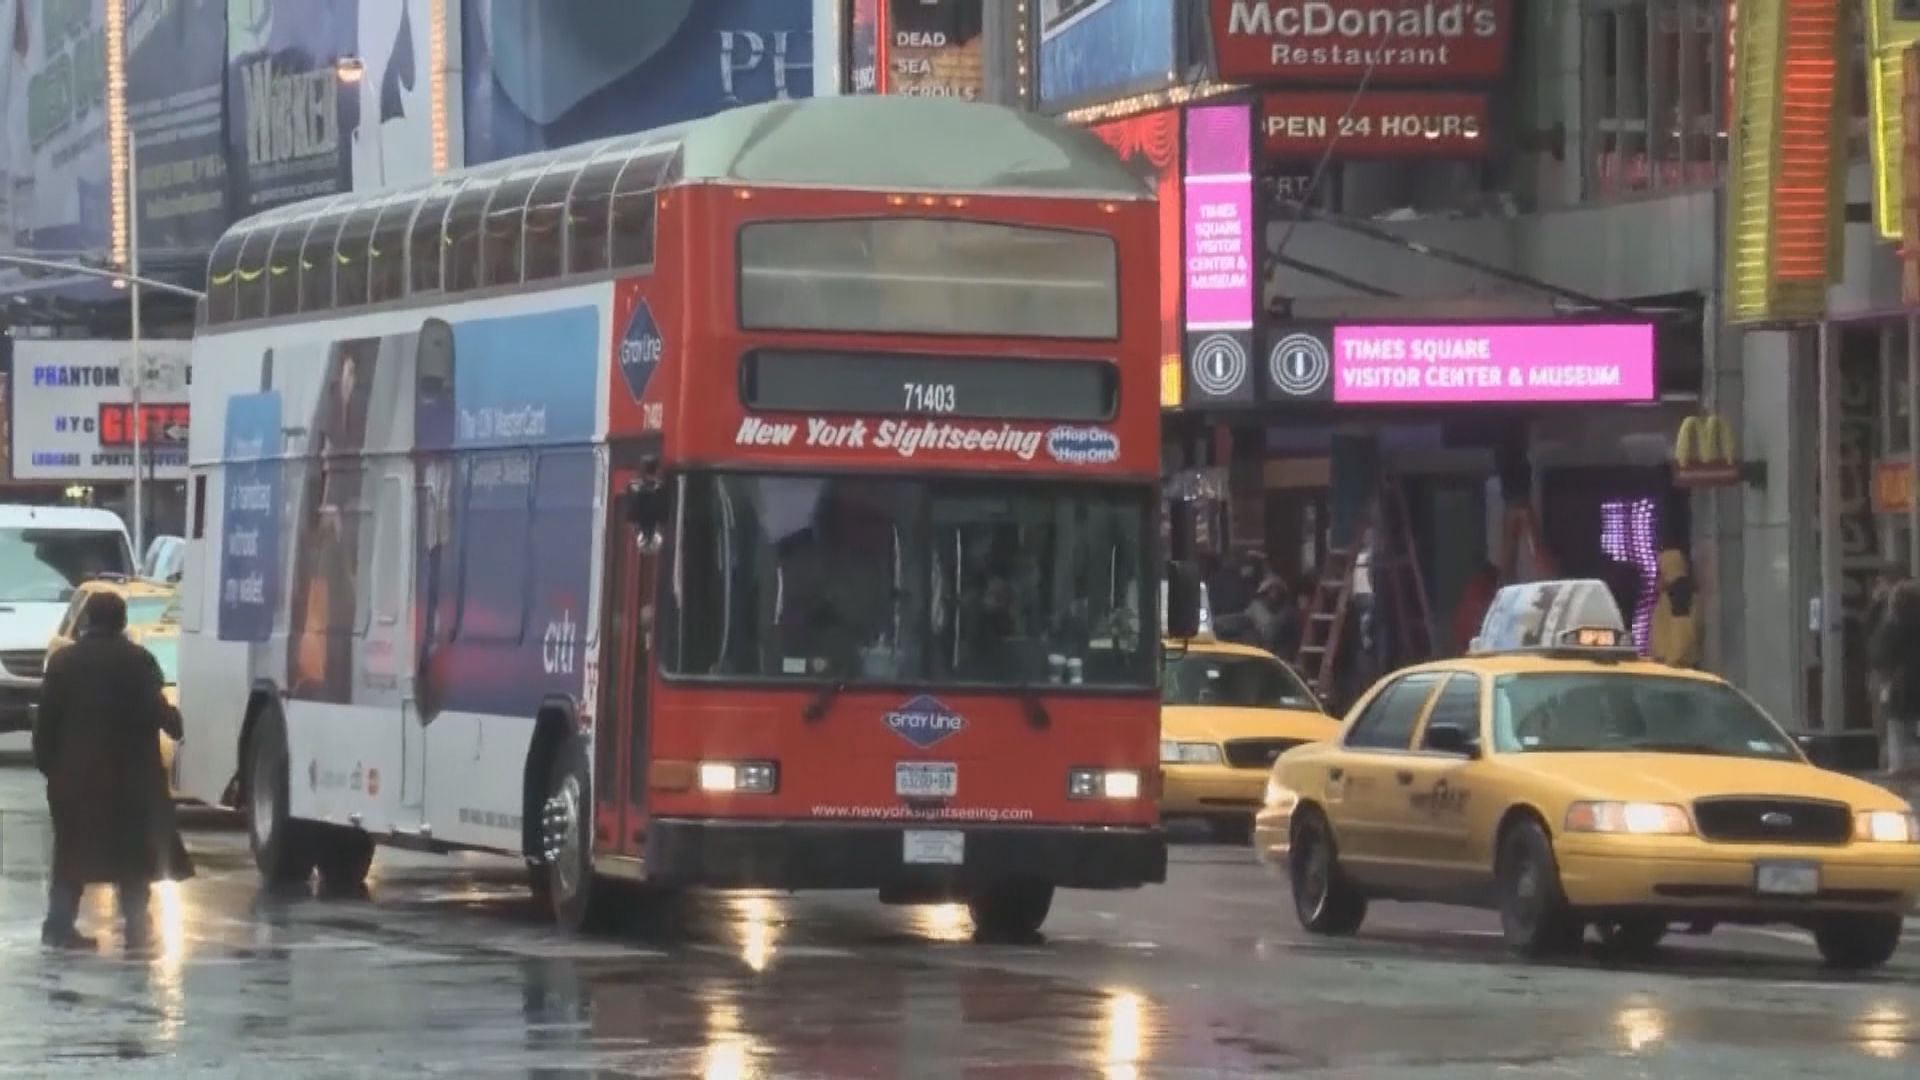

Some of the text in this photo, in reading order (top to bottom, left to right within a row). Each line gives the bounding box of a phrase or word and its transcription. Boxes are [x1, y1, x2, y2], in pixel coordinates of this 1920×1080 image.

[1228, 2, 1497, 37] McDonald's
[897, 31, 946, 47] DEAD
[1271, 44, 1450, 65] Restaurant
[898, 59, 931, 74] SEA
[1262, 115, 1479, 138] PEN 24 HOURS
[1200, 203, 1238, 218] TIMES
[1195, 221, 1241, 238] SQUARE
[1196, 239, 1241, 254] VISITOR
[1190, 257, 1234, 272] CENTER
[1343, 338, 1490, 361] TIMES SQUARE
[34, 366, 120, 387] PHANTOM
[1343, 365, 1621, 388] VISITOR CENTER & MUSEUM
[904, 383, 956, 412] 71403
[735, 417, 1041, 460] New York Sightseeing
[811, 803, 1033, 822] www.newyorksightseeing.com
